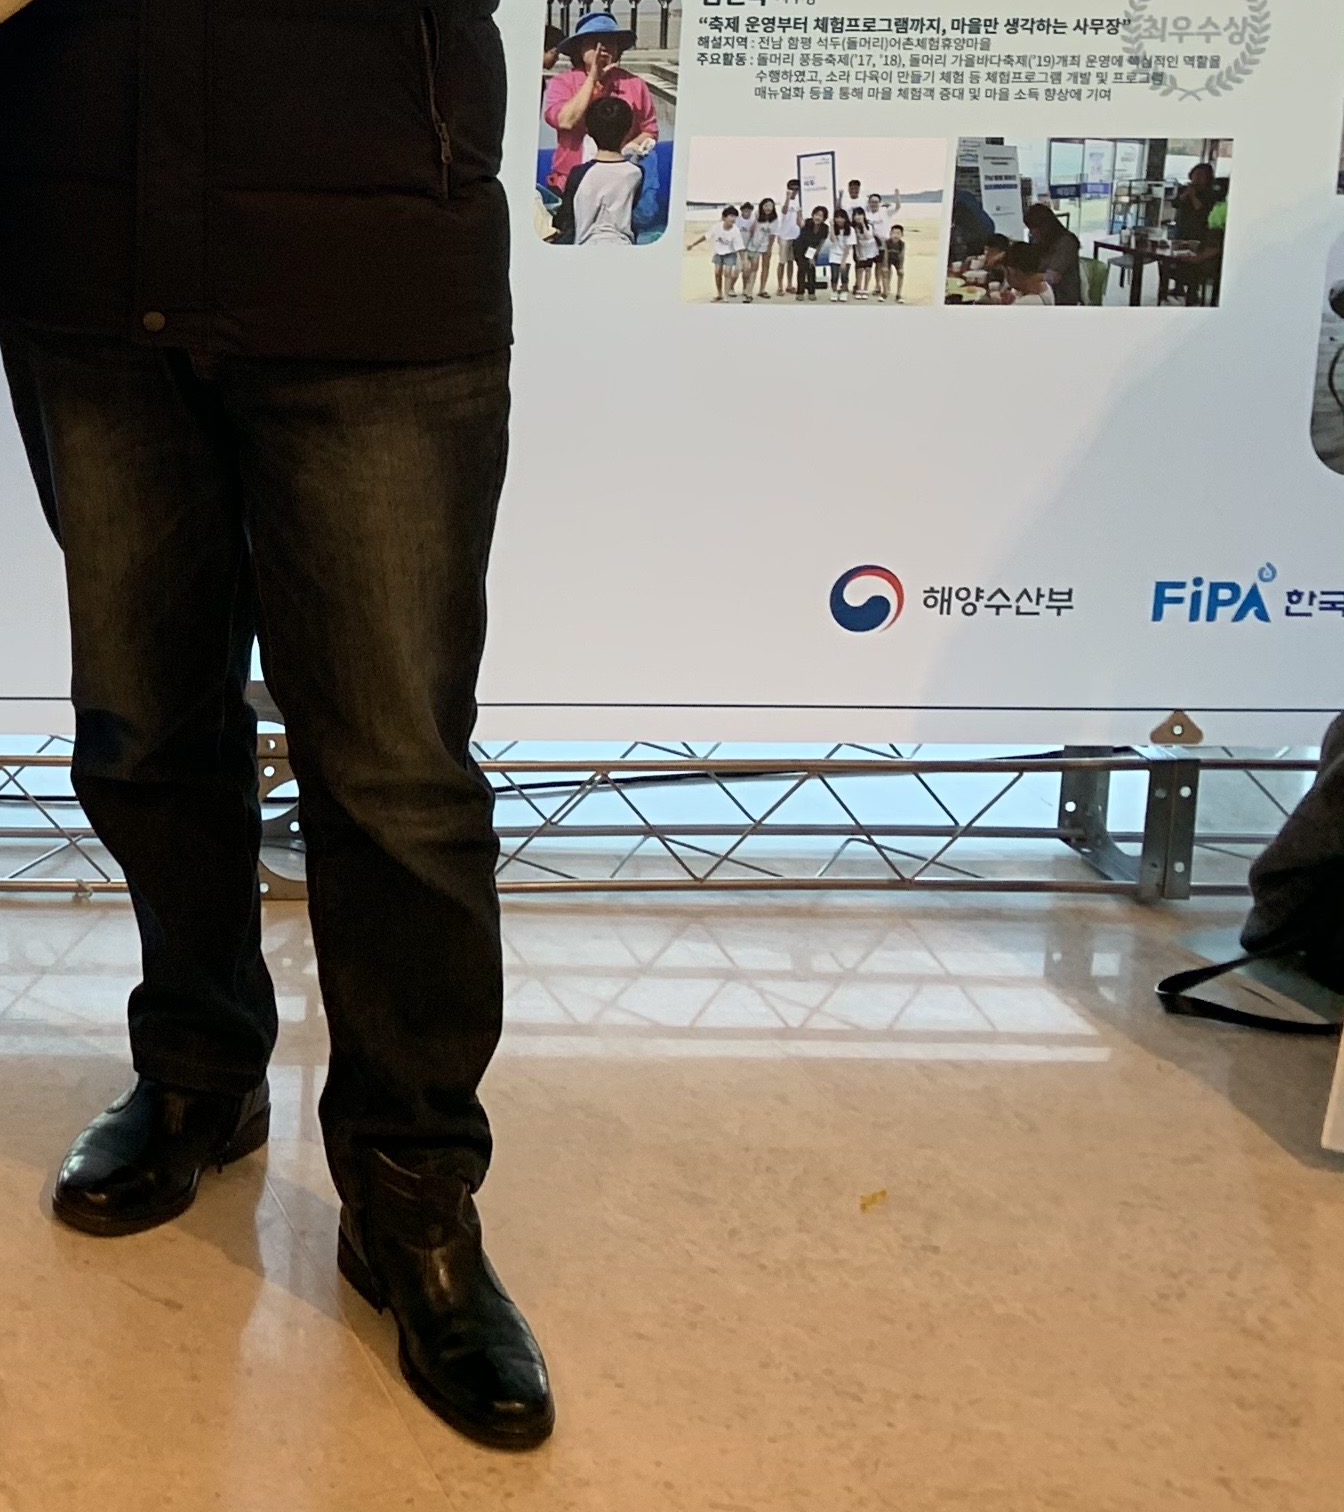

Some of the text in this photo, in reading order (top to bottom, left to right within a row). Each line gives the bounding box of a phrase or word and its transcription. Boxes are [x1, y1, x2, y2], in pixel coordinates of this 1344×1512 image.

[699, 16, 1132, 35] “축제 운영부터 체험프로그램까지, 마을만 생각하는 사무장”
[1139, 15, 1248, 45] 최우수상
[923, 586, 1074, 617] 해양수산부
